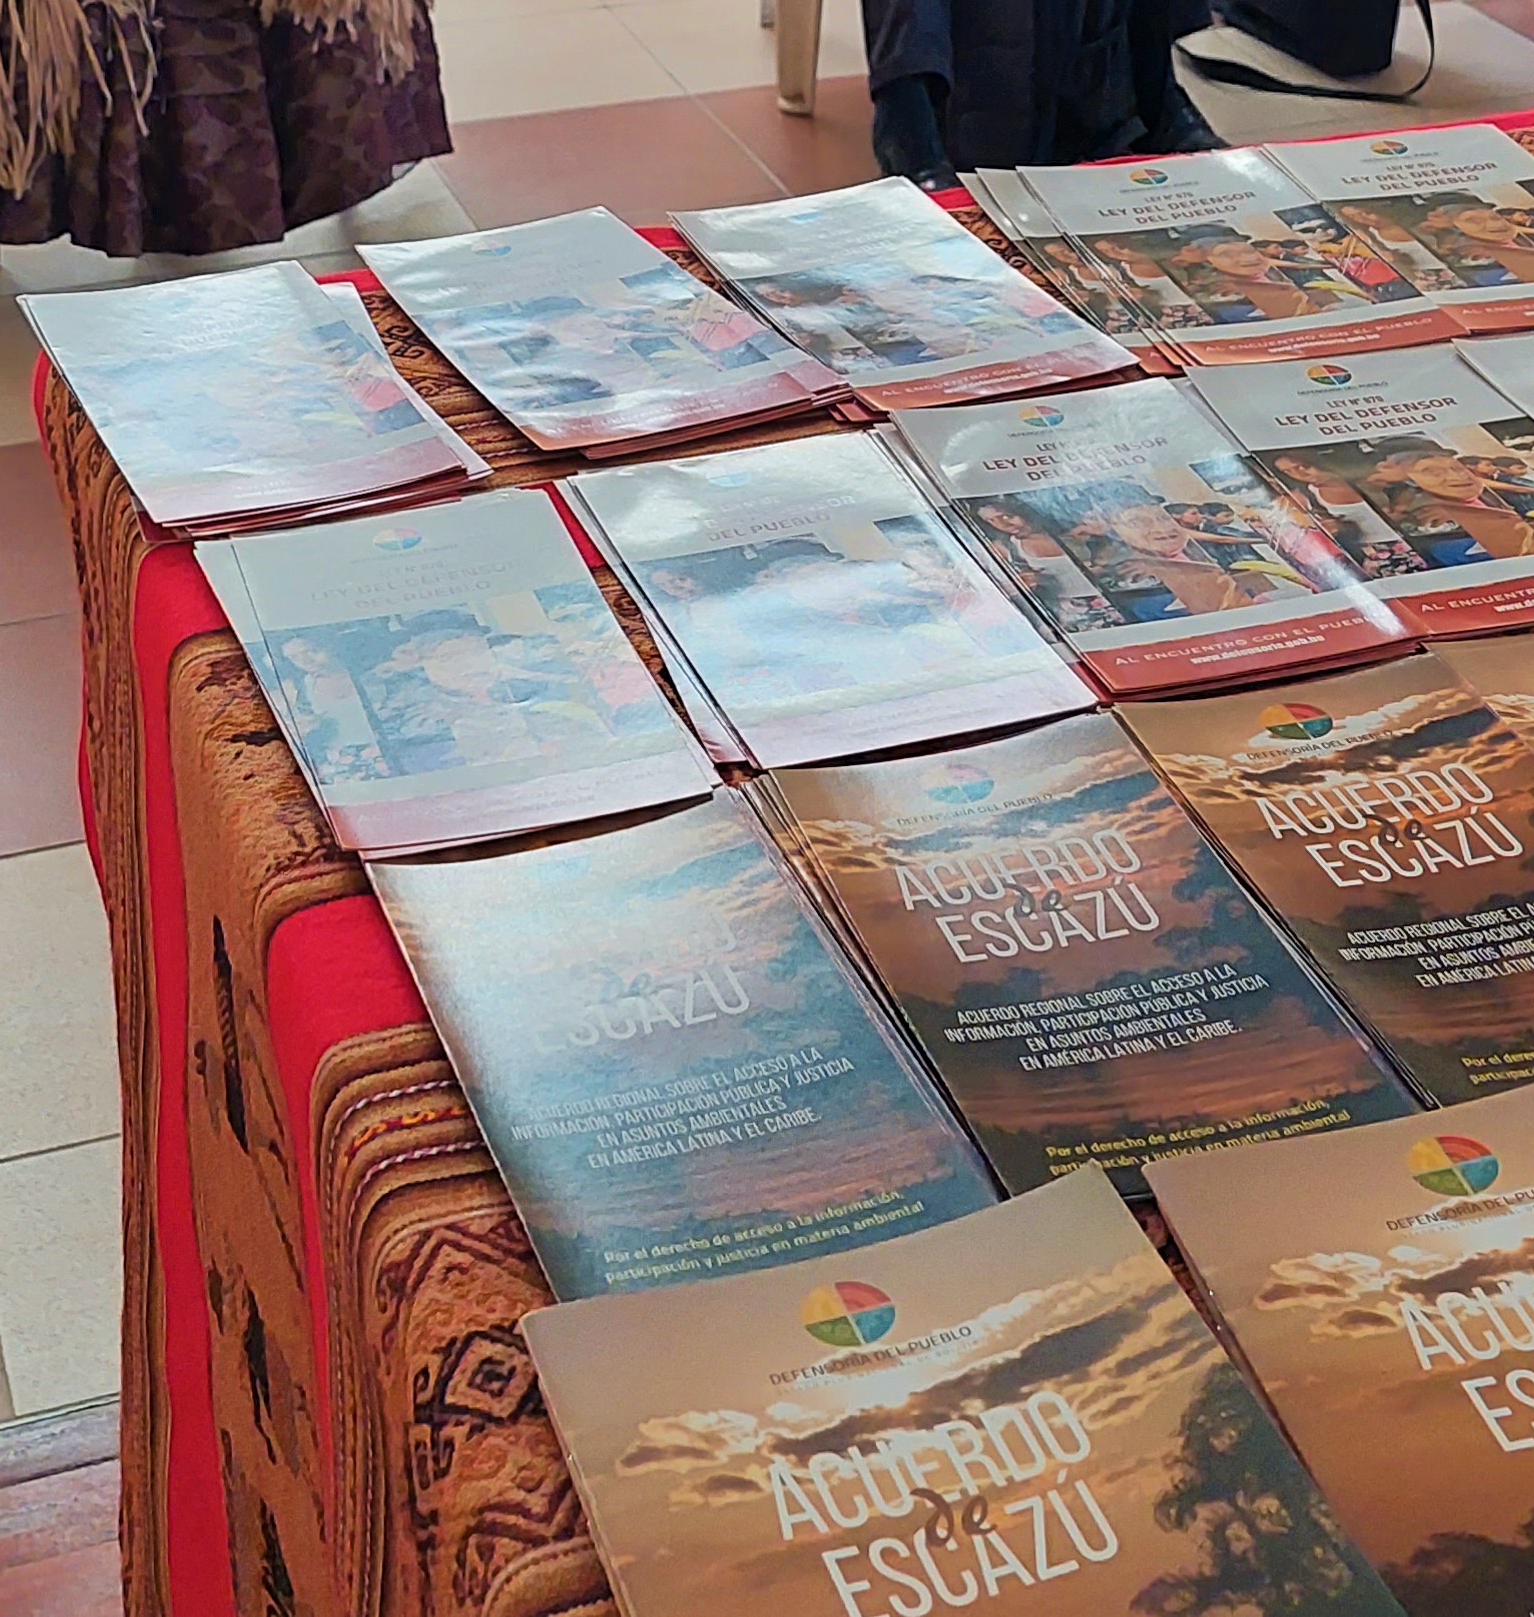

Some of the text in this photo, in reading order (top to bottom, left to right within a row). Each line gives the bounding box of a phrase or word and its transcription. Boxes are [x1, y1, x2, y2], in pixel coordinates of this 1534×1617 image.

[1342, 175, 1368, 184] LEY
[1409, 163, 1498, 177] DEFENSOR
[1414, 174, 1479, 187] PUEBLO
[1098, 192, 1257, 217] LEY DEL DEFENSOR
[1135, 206, 1237, 223] DEL PUEBLO
[1274, 398, 1457, 426] LEY DEL DEFENSOR
[1319, 414, 1436, 435] DEL PUEBLO
[982, 458, 1015, 470] LEY
[1023, 455, 1061, 467] DEL
[1116, 656, 1138, 665] AL
[1144, 639, 1245, 659] ENCUENTRO
[1252, 632, 1289, 642] CON
[1260, 763, 1493, 838] ACUERDO
[1305, 805, 1524, 887] ESCAZÚ
[897, 830, 1140, 910] ACUERDO
[935, 875, 1161, 963] ESCAZÚ
[957, 963, 1237, 1025] ACUERDO REGIONAL SOBRE EL ACCESO A LA
[1195, 988, 1207, 1001] Y
[1211, 974, 1271, 998] JUSTICIA
[1025, 1008, 1206, 1051] EN ASUNTOS AMBIENTALES
[1019, 1056, 1042, 1070] EN
[1102, 1036, 1157, 1058] LATINA
[1153, 1035, 1165, 1048] Y
[1165, 1031, 1187, 1045] EL
[1481, 1195, 1514, 1210] DEL
[872, 1345, 906, 1361] DEL
[906, 1325, 972, 1352] PUEBLO
[772, 1389, 1091, 1541] ACUERDO
[913, 1489, 997, 1546] de
[822, 1472, 1121, 1617] ESCAZÚ
